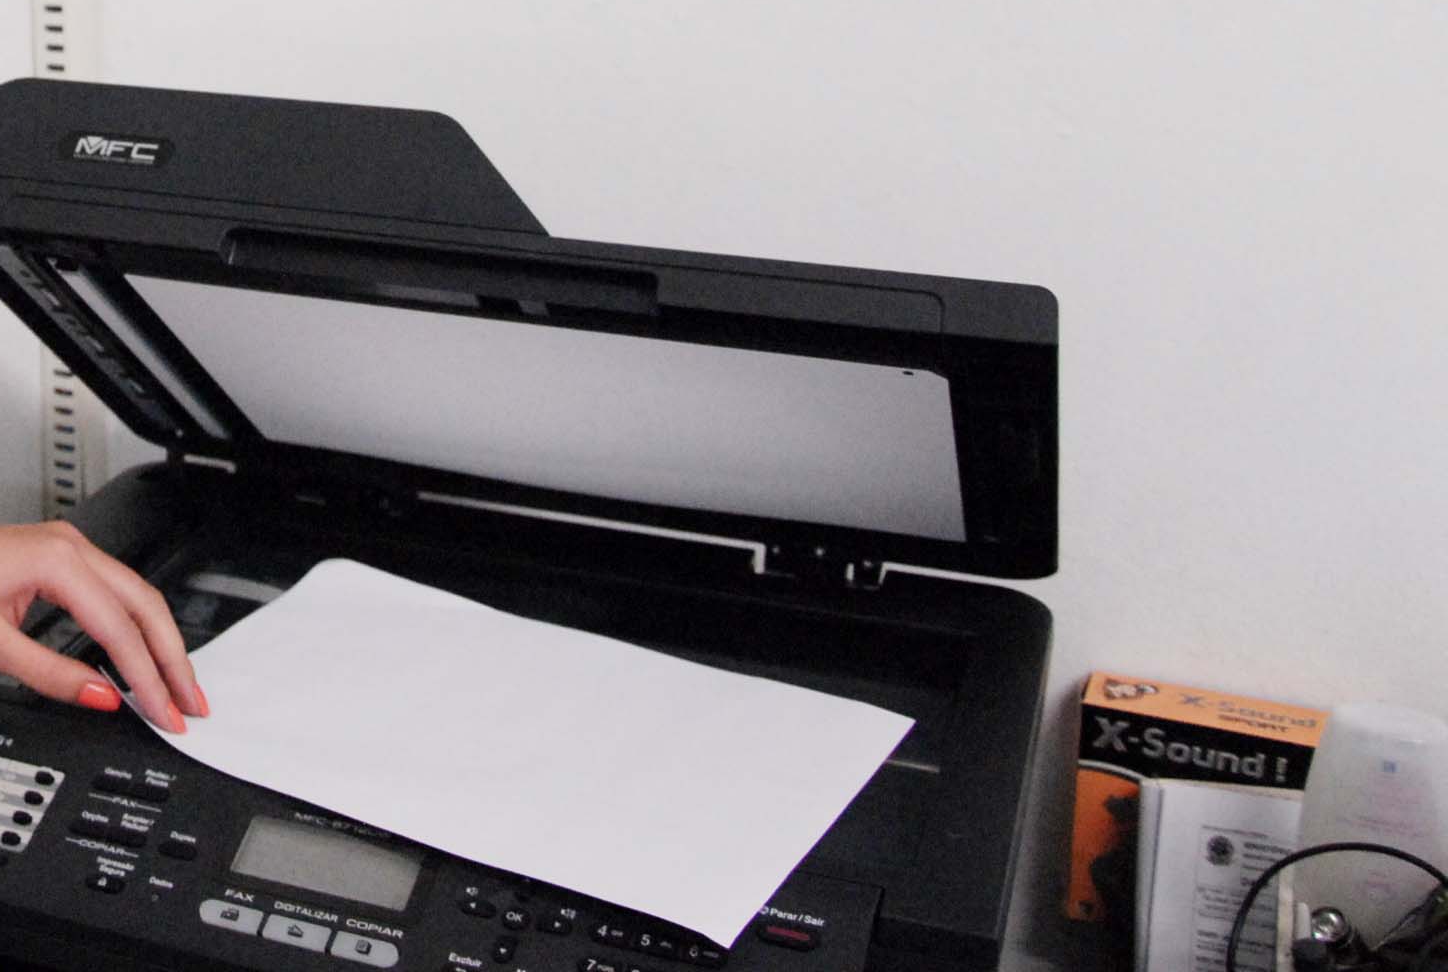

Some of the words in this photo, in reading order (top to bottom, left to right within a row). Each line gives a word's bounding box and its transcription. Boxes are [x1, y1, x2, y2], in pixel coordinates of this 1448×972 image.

[75, 135, 159, 160] MFC
[1093, 716, 1266, 779] X-Sound
[224, 888, 254, 902] FAX
[273, 900, 339, 923] DIGITALIZAR
[505, 911, 524, 922] OK
[345, 917, 404, 939] COPIAR
[597, 925, 608, 937] 4
[640, 934, 651, 946] 5
[586, 958, 597, 971] 7
